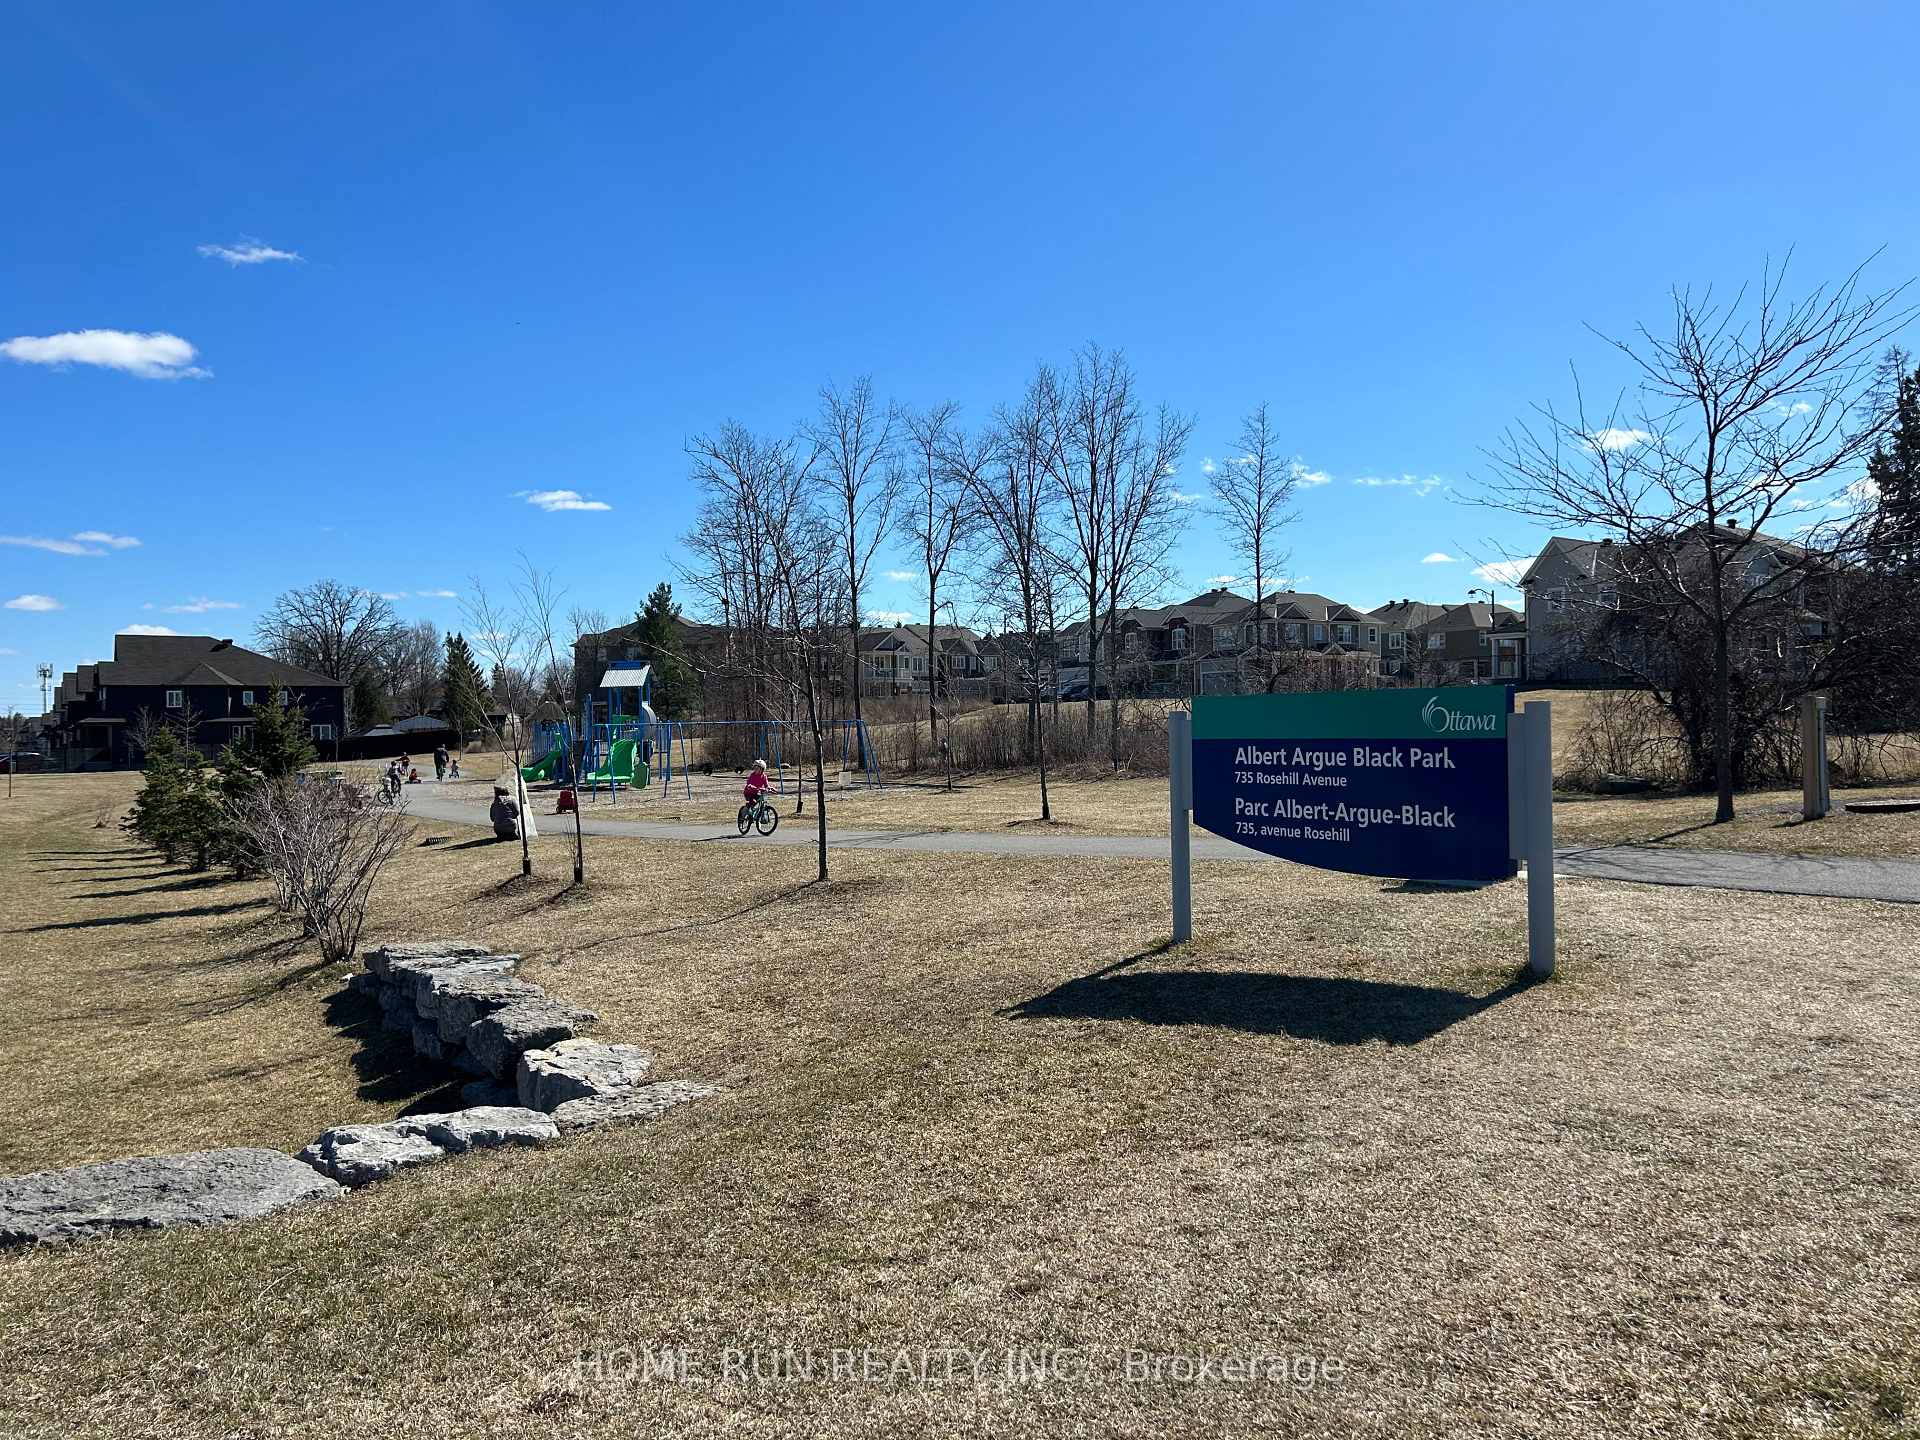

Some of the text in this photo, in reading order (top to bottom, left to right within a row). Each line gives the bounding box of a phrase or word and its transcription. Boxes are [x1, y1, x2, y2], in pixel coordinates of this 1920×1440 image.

[1422, 697, 1496, 732] Ottawa
[1235, 745, 1456, 771] Albert Argue Black Park
[1235, 771, 1347, 787] 735 Rosehill Avenue
[1235, 797, 1456, 828] Parc Albert-Argue-Black
[1235, 822, 1350, 841] 735, avenue Rosehill
